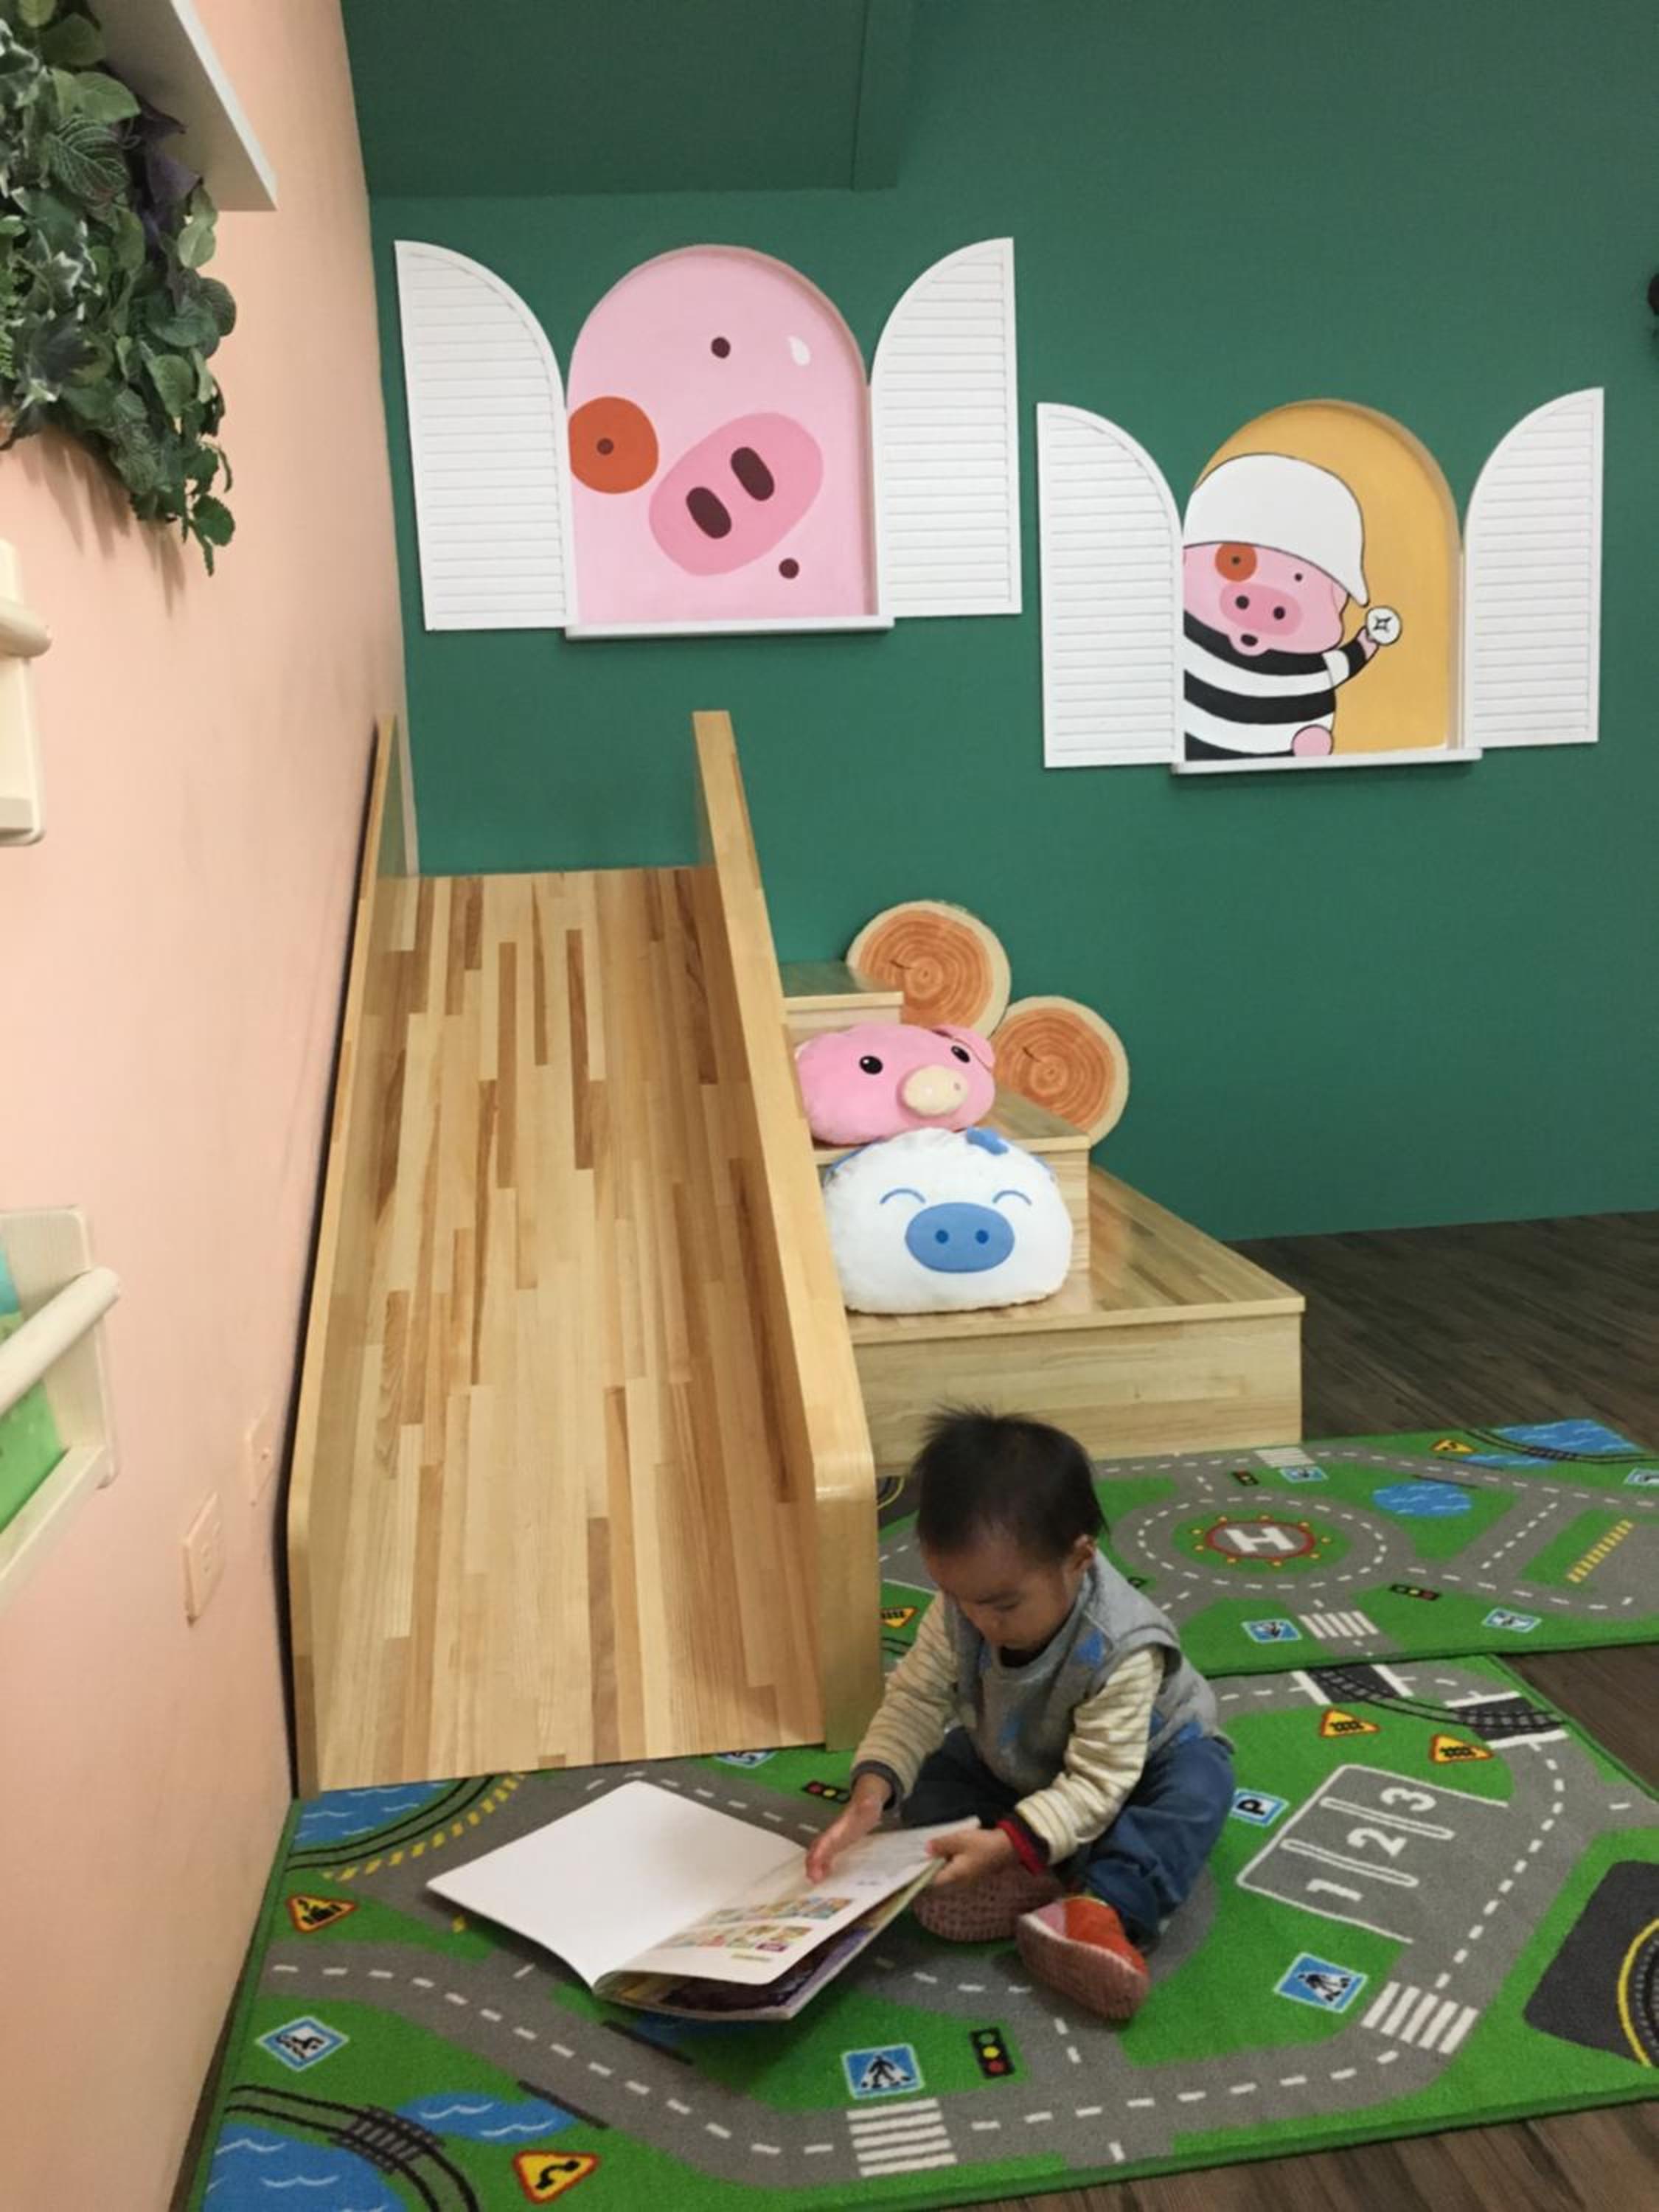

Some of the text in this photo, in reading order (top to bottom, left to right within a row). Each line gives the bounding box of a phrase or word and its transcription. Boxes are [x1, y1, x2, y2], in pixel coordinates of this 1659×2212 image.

[1225, 1526, 1295, 1552] H
[1237, 1800, 1265, 1815] P
[1380, 1787, 1436, 1811] 3
[1347, 1828, 1406, 1857] 2
[1306, 1879, 1363, 1902] 1
